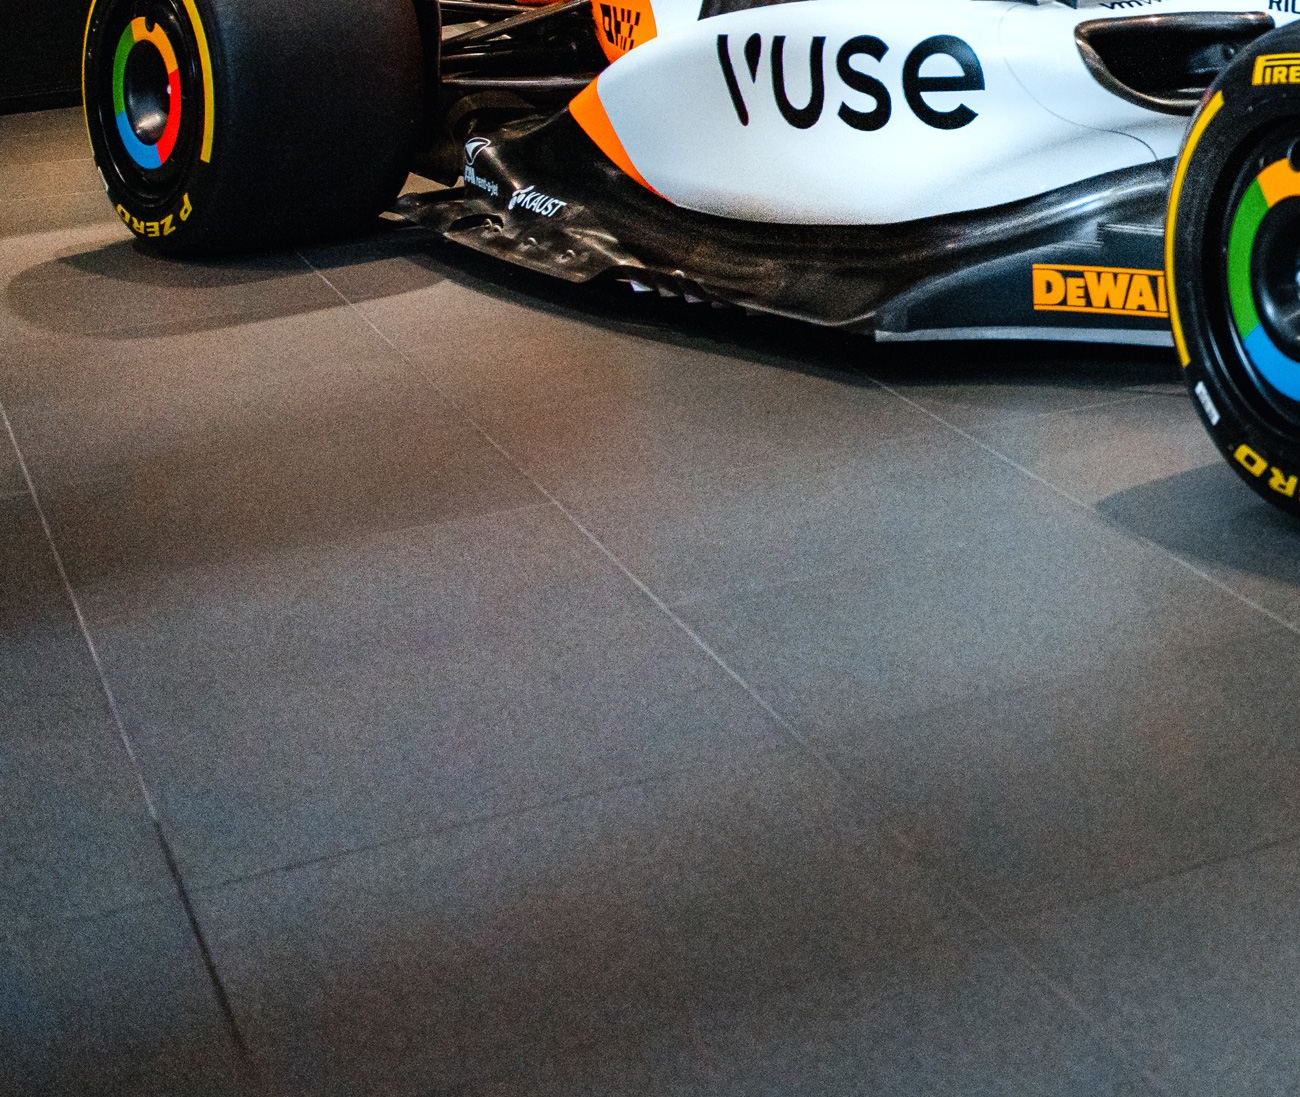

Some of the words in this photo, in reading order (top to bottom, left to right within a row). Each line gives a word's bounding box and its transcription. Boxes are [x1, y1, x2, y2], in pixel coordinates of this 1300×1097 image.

[179, 192, 193, 222] P
[521, 190, 568, 218] KAUST
[116, 203, 177, 238] ZERO
